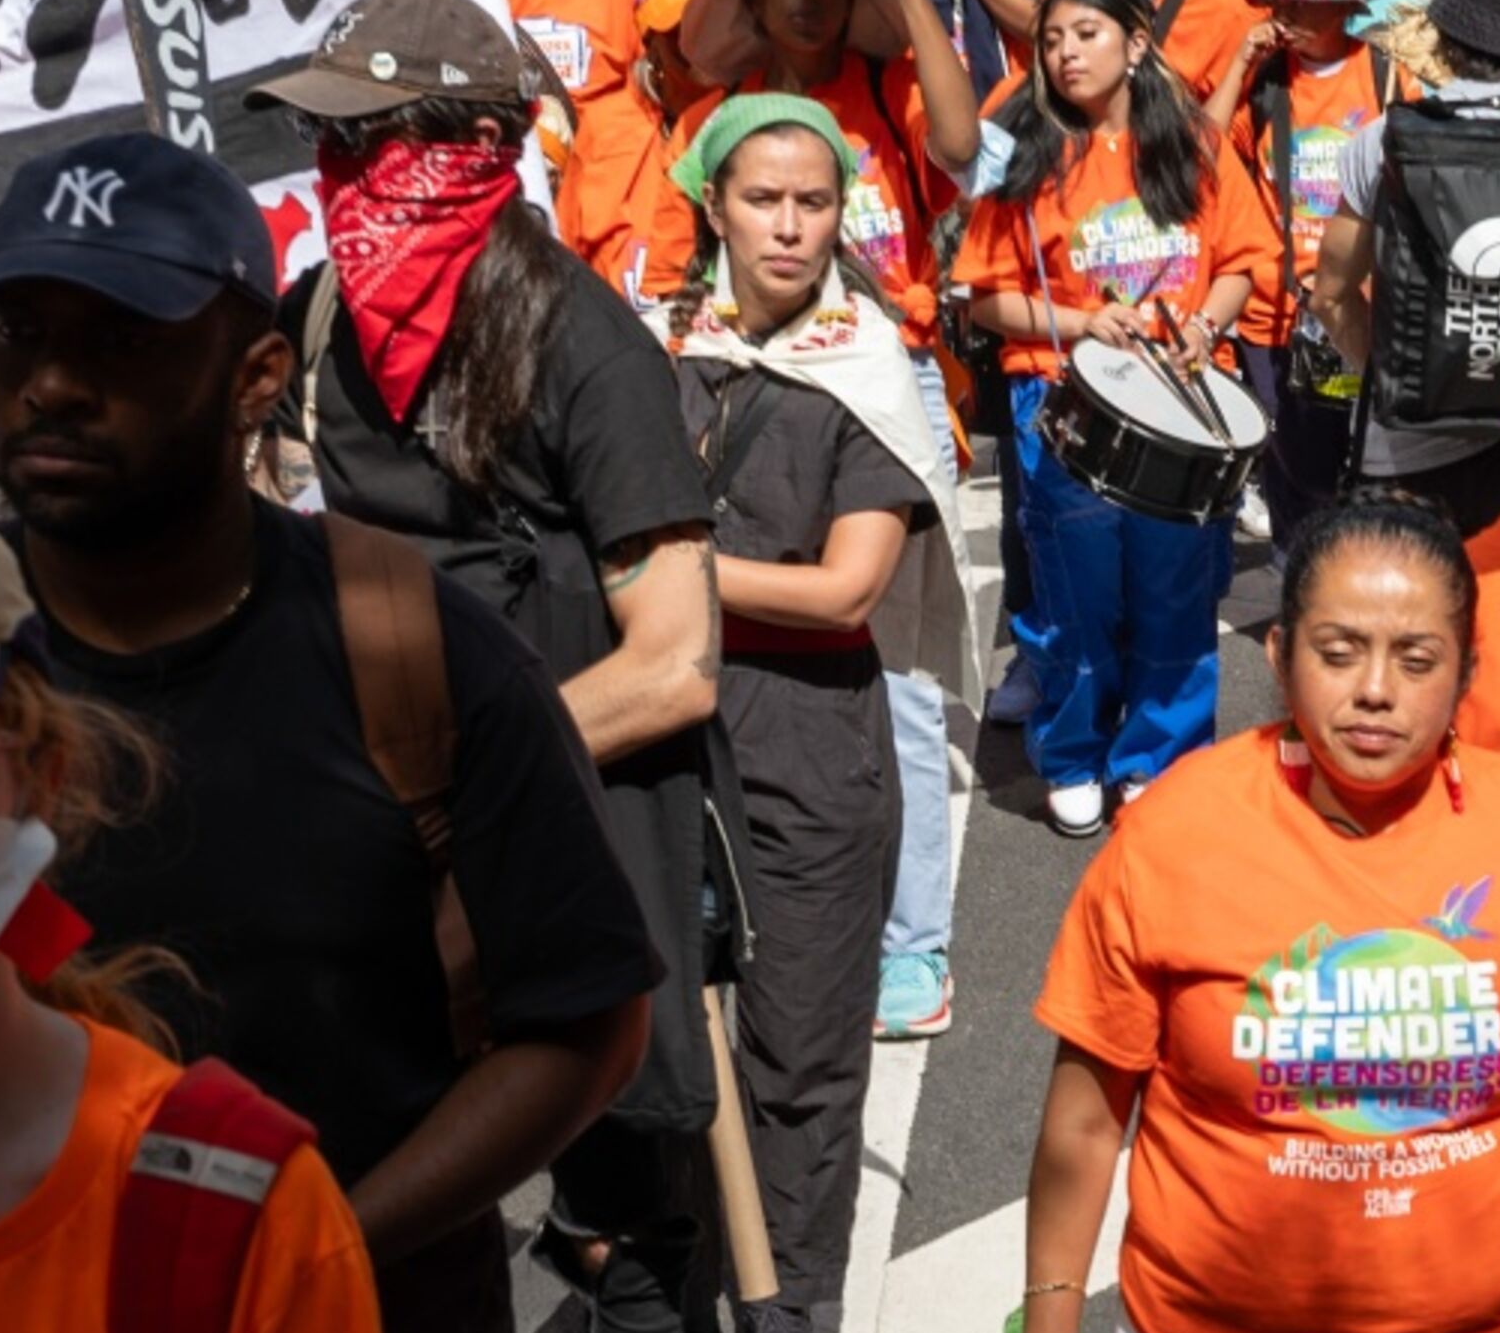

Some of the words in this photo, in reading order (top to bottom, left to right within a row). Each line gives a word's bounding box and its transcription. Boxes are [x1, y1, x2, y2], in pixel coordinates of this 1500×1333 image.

[1070, 234, 1199, 270] DEFENDERS
[1444, 267, 1471, 336] THE
[1467, 281, 1499, 380] NORTH
[1272, 961, 1498, 1014] CLIMATE
[1260, 1053, 1497, 1087] DEFENSORES
[1254, 1089, 1299, 1114] DE
[1314, 1087, 1355, 1110] LA
[1373, 1081, 1497, 1112] TIERRA
[1268, 1155, 1374, 1182] WITHOUT
[1379, 1150, 1447, 1180] FOSSIL
[1448, 1131, 1498, 1162] FUELS
[1285, 1135, 1388, 1163] BUILDING
[1392, 1136, 1408, 1159] A
